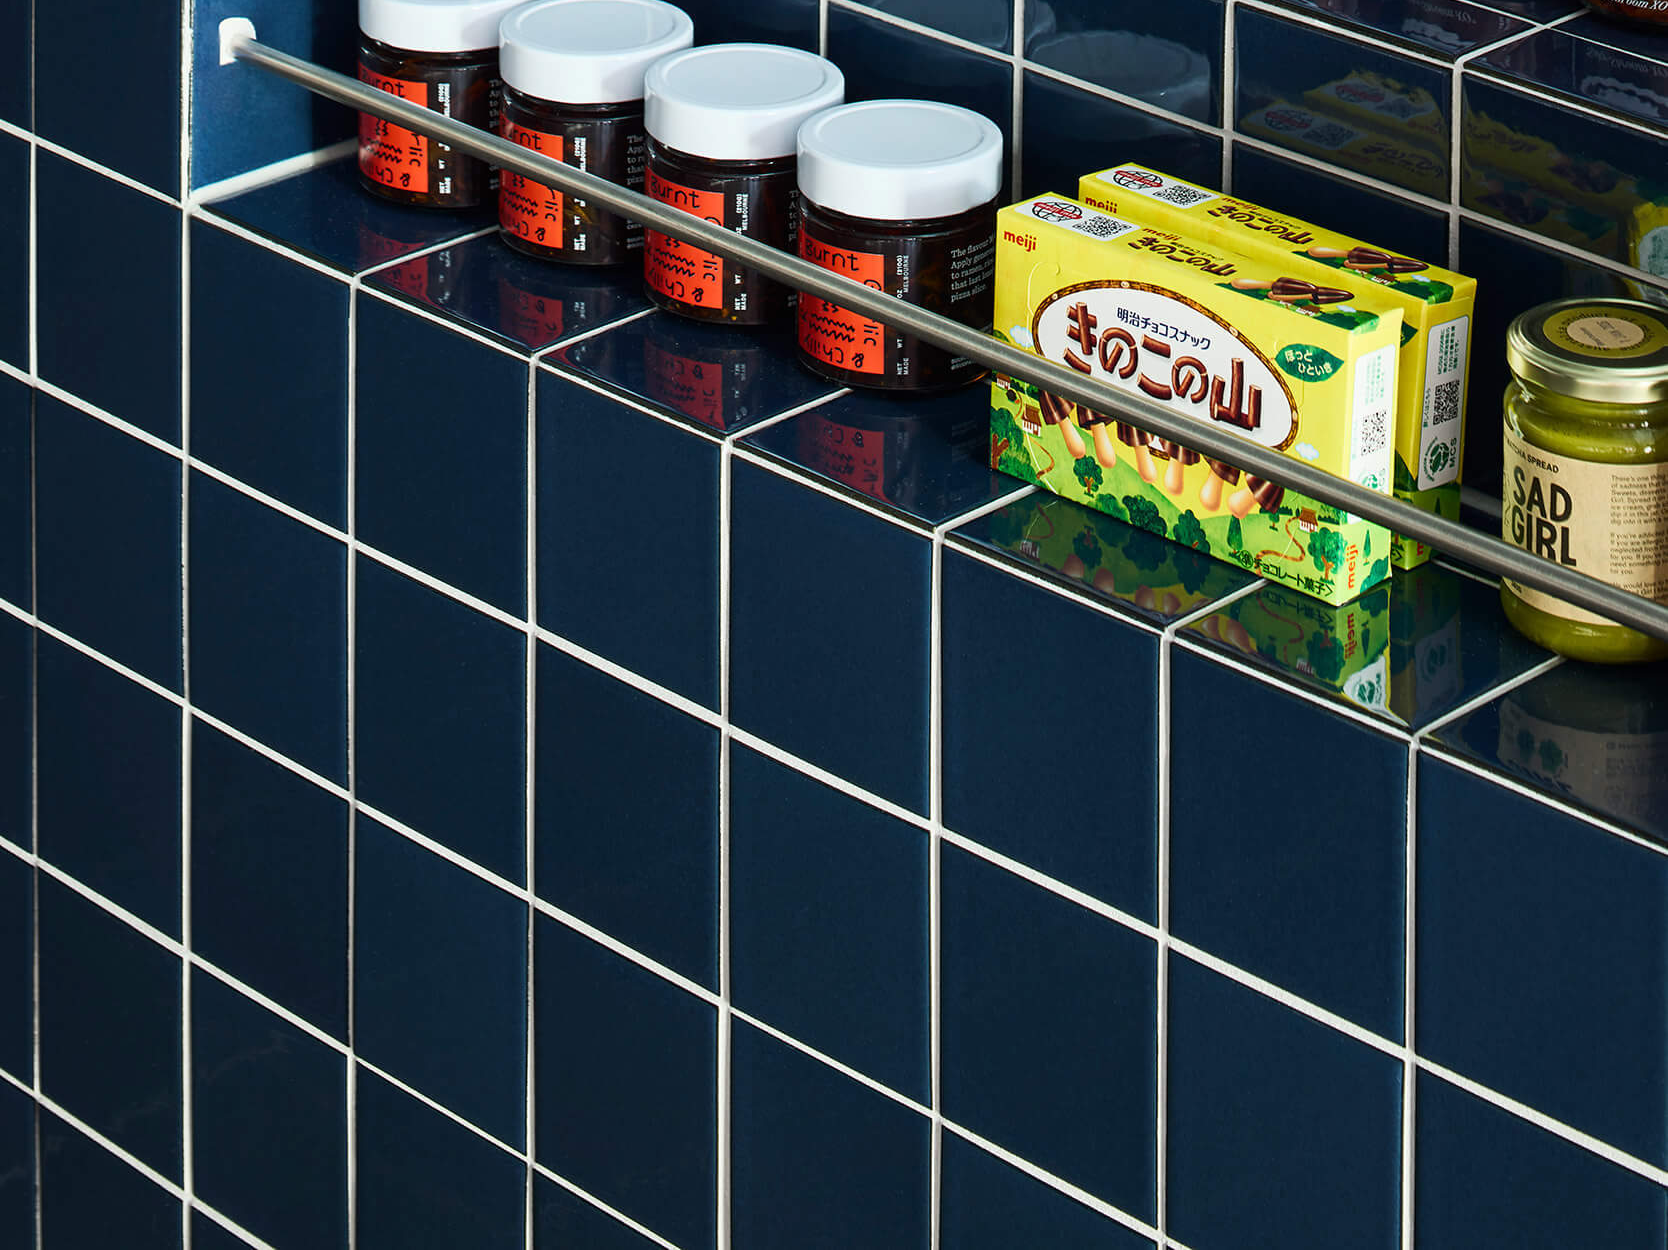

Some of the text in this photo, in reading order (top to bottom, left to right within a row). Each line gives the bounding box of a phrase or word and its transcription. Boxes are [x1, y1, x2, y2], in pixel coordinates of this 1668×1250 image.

[1221, 196, 1261, 211] meiji
[1207, 204, 1316, 245] きのこの山
[1003, 230, 1037, 252] meiji
[1142, 227, 1183, 242] meiji
[951, 248, 967, 258] The
[1127, 236, 1238, 277] きのこの山
[951, 257, 973, 270] Apply
[951, 272, 960, 280] to
[951, 280, 967, 290] that
[692, 288, 704, 302] &
[1116, 307, 1211, 350] 明治チョコスナック
[896, 338, 903, 349] WT
[851, 353, 865, 368] &
[1284, 347, 1314, 363] ほっと
[1063, 301, 1264, 431] きのこの山
[1297, 361, 1333, 377] ひといき
[1449, 437, 1458, 468] MCS
[1506, 438, 1560, 474] ATCHA SPREAD
[1513, 465, 1573, 523] SAD
[1512, 504, 1577, 567] GIRL
[1345, 544, 1359, 589] meiji
